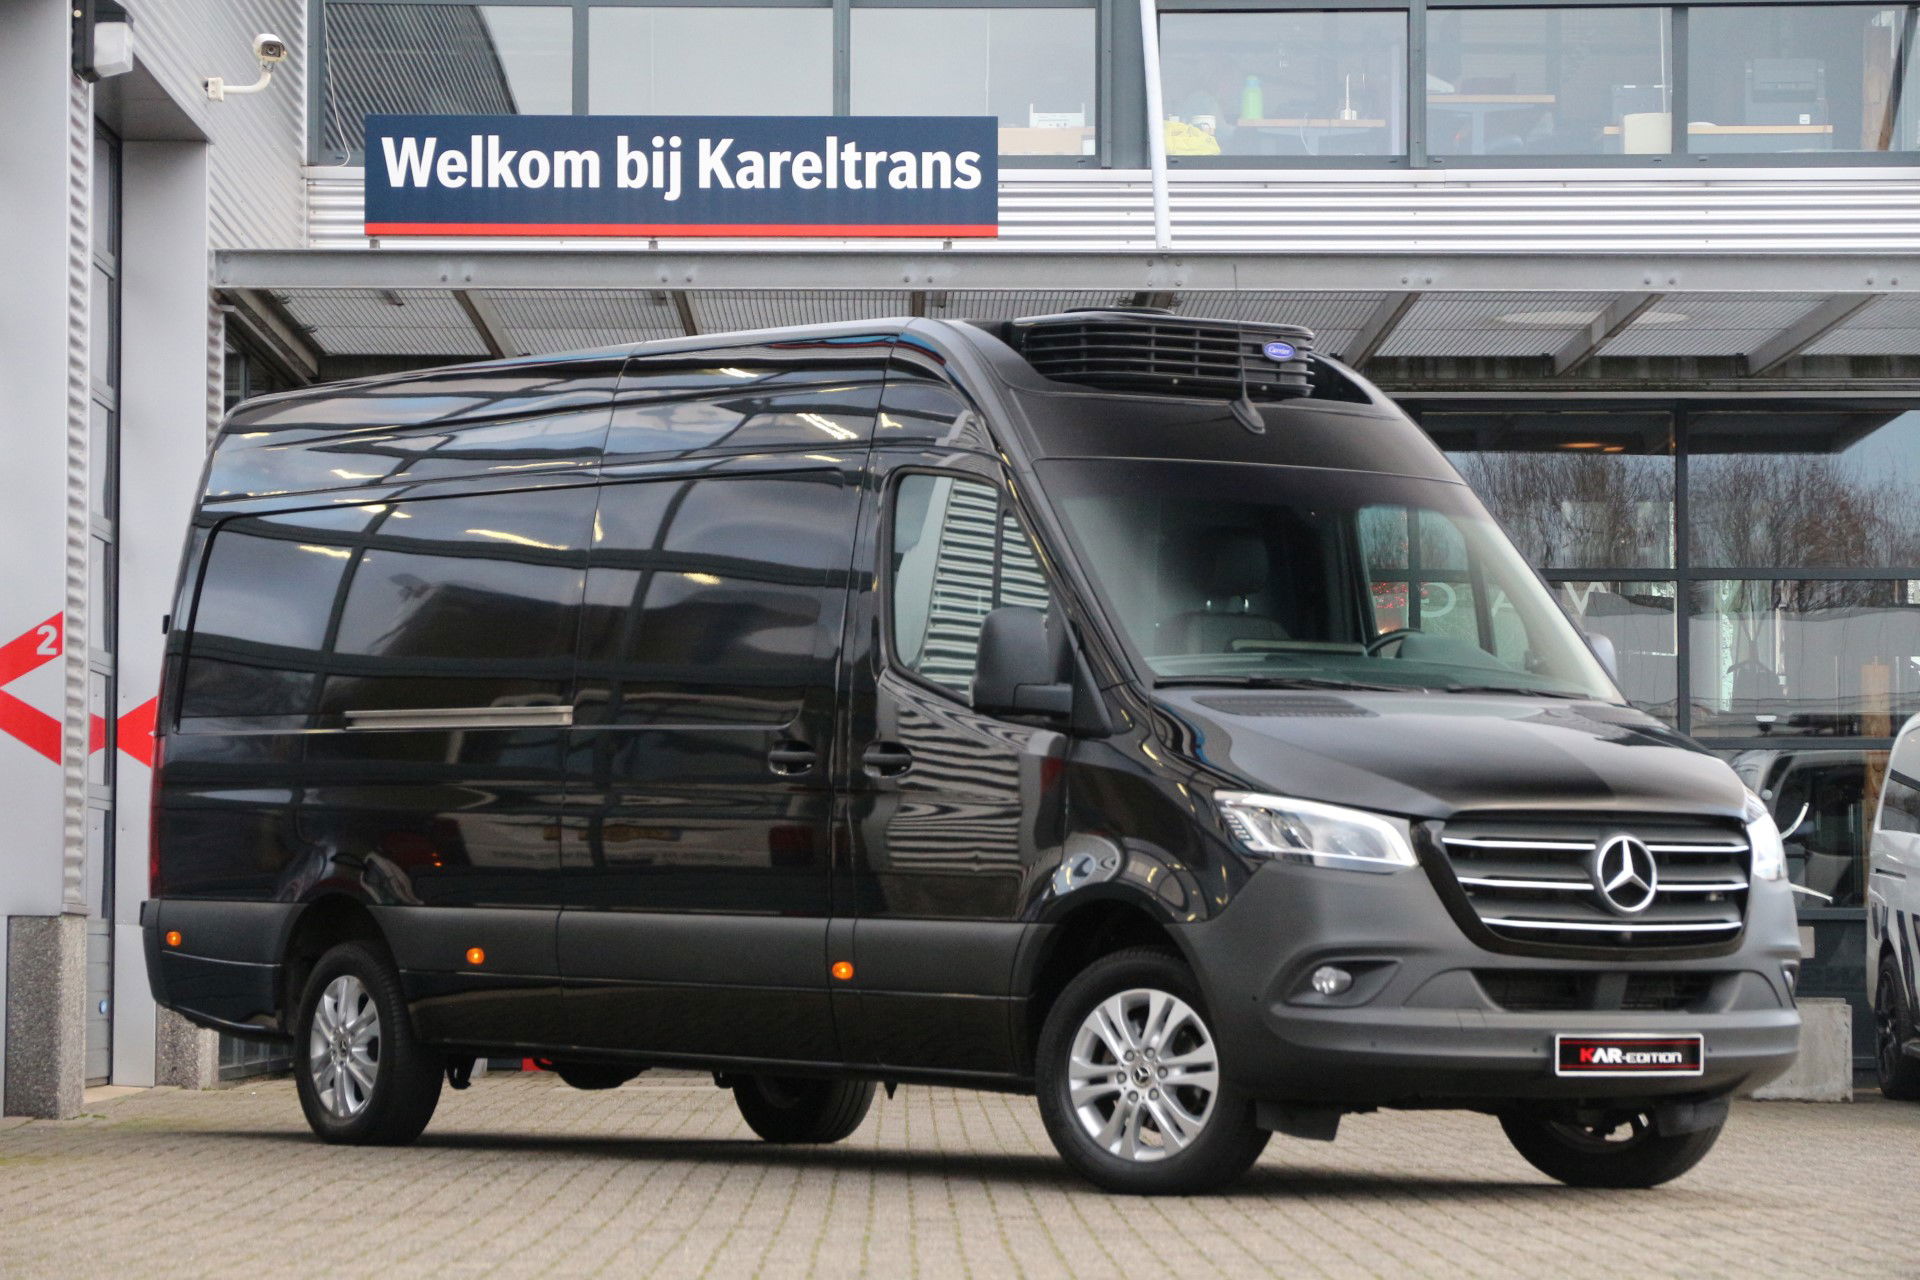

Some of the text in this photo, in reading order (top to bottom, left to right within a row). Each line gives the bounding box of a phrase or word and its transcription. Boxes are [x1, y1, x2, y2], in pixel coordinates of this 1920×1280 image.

[381, 134, 982, 202] Welkom bij Kareltrans
[36, 625, 57, 655] 2
